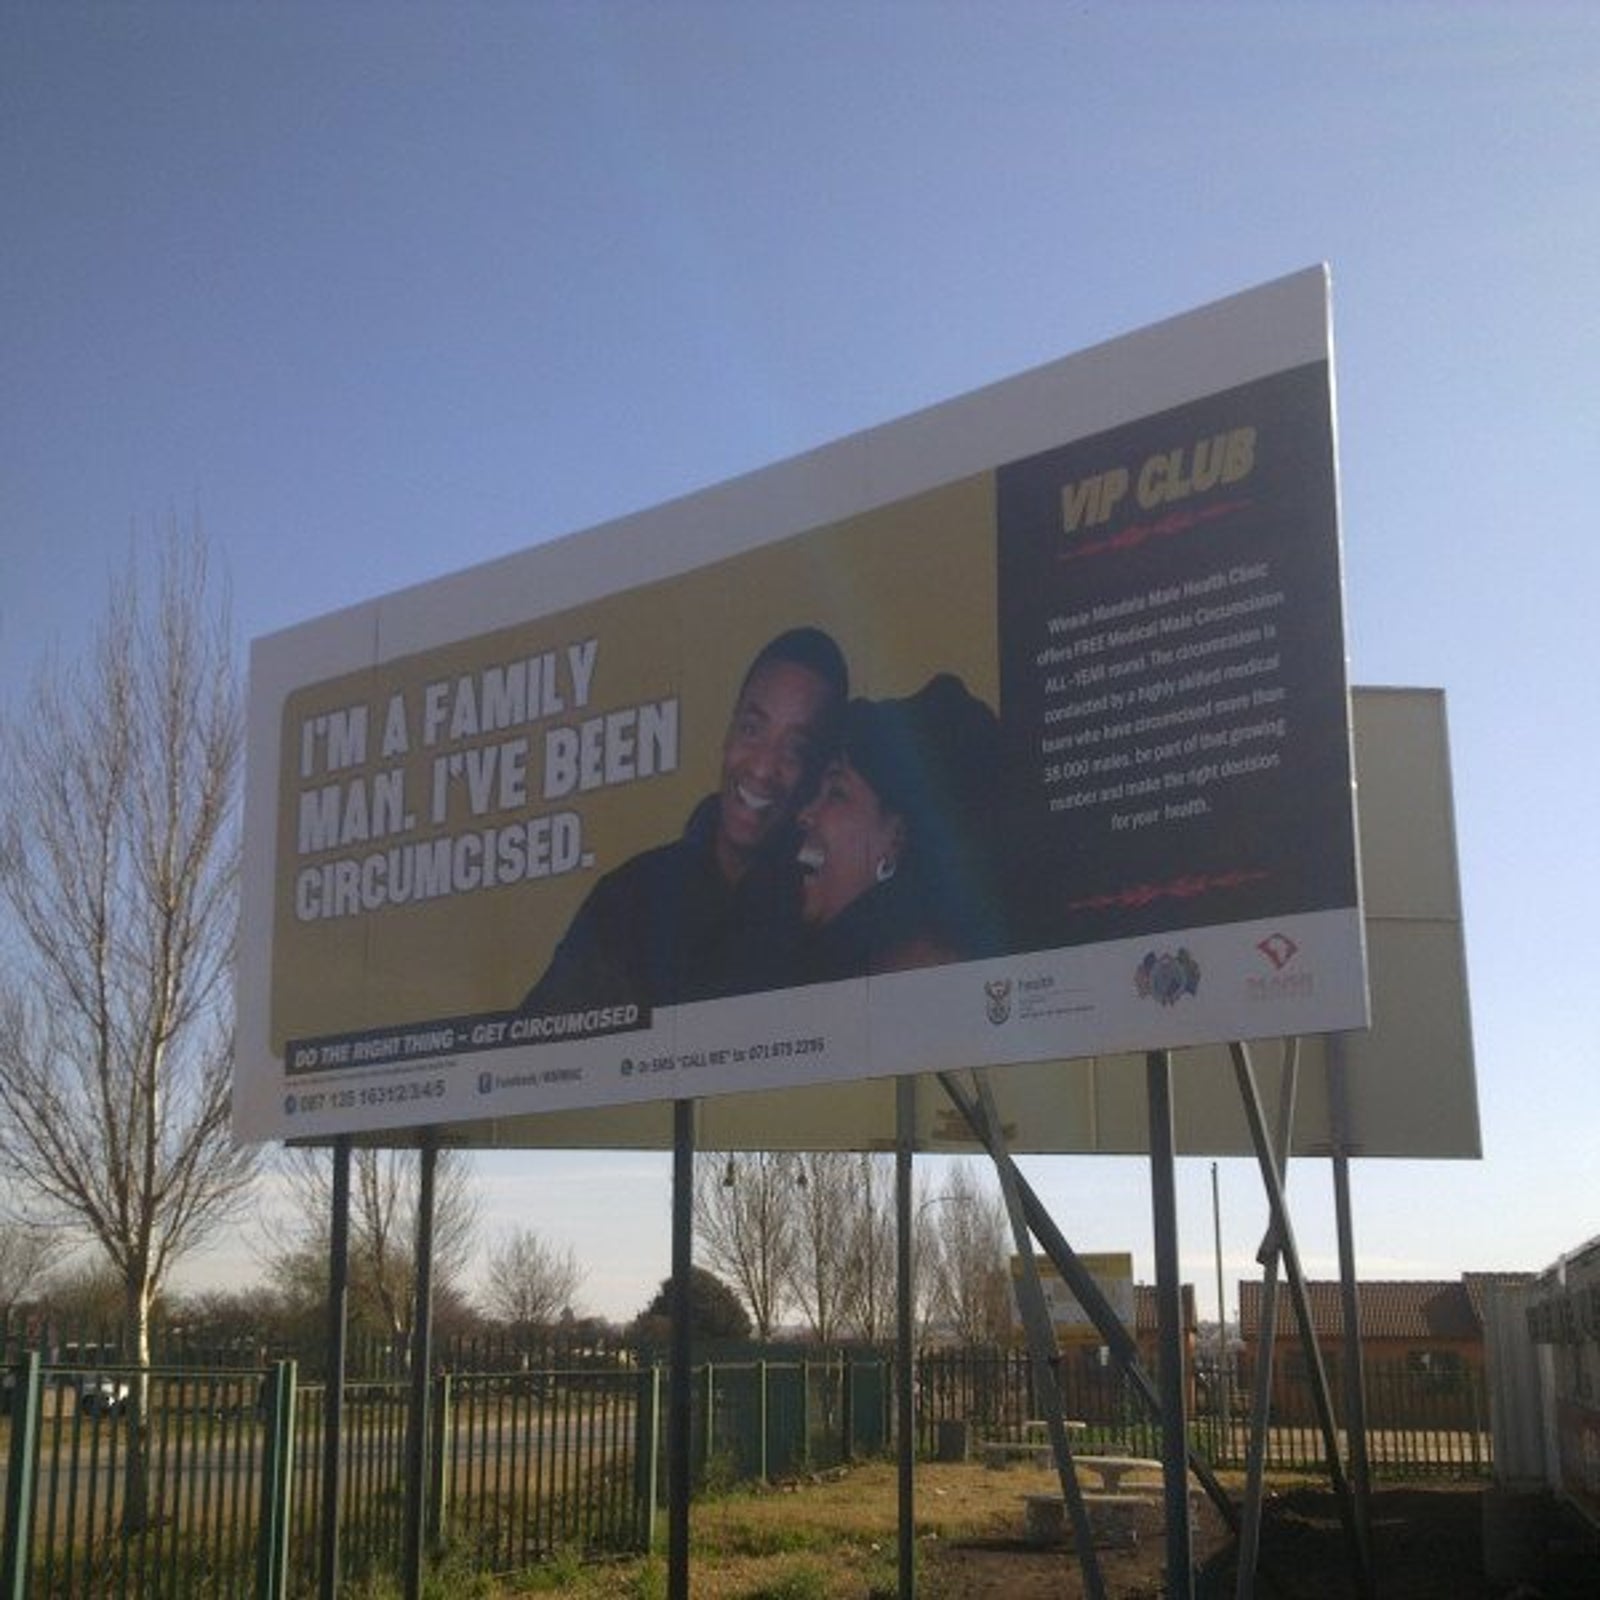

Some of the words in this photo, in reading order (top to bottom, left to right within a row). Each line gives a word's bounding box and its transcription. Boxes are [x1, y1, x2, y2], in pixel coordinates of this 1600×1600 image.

[1061, 468, 1128, 533] VIP
[1136, 427, 1256, 508] CLUB
[1228, 561, 1269, 585] Clinic
[1036, 646, 1073, 667] offers
[1073, 634, 1106, 657] FREE
[1106, 619, 1158, 648] Medical
[1159, 613, 1192, 634] Male
[1137, 679, 1175, 705] highly
[1223, 652, 1280, 681] medical
[300, 706, 370, 778] I'M
[383, 694, 409, 758] A
[422, 639, 598, 746] FAMILY
[1103, 721, 1132, 741] have
[297, 768, 417, 855] MAN.
[431, 737, 529, 824] I'VE
[544, 699, 680, 800] BEEN
[1153, 740, 1182, 763] part
[295, 811, 596, 922] CIRCUMCISED.
[293, 1048, 318, 1068] DO
[320, 1042, 350, 1064] THE
[351, 1035, 402, 1061] RIGHT
[402, 1027, 454, 1055] THING
[471, 1020, 506, 1045] GET
[510, 1003, 640, 1038] CIRCUMCISED
